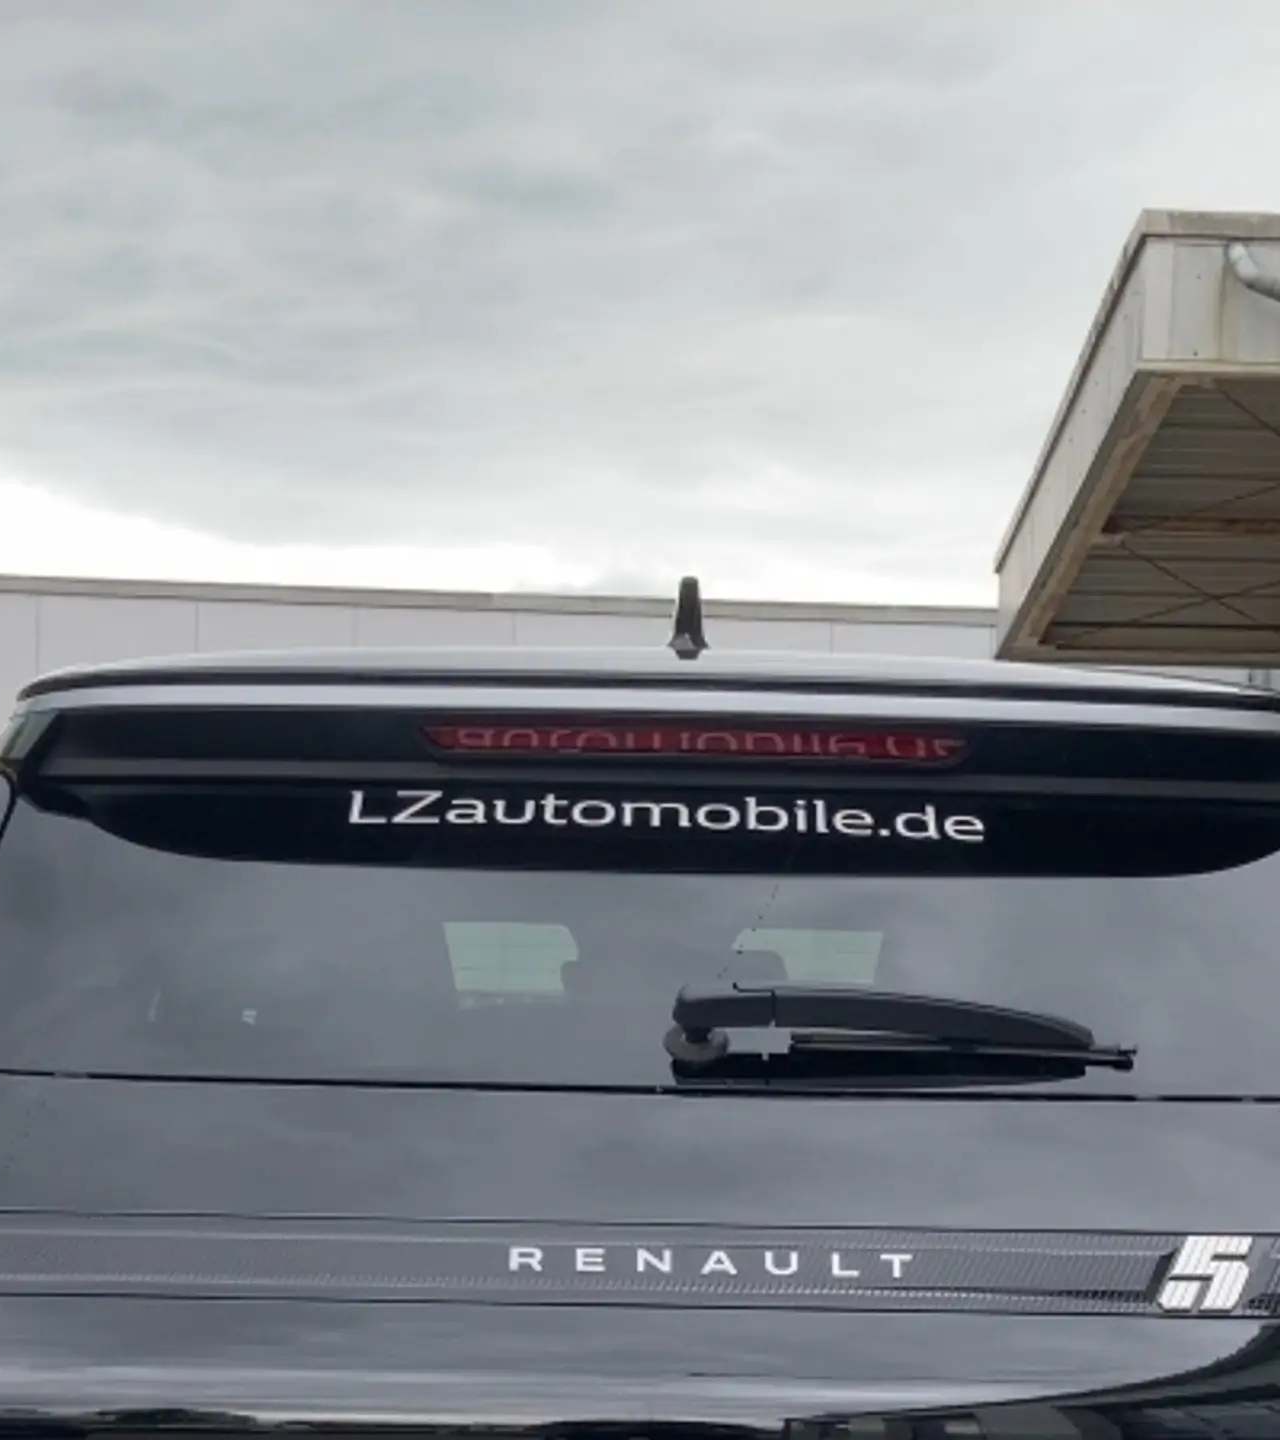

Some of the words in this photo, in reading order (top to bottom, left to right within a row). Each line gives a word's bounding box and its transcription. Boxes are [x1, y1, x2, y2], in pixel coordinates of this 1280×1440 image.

[346, 789, 986, 842] LZautomobile.de
[508, 1245, 913, 1279] RENAULT
[1157, 1235, 1253, 1313] 5
